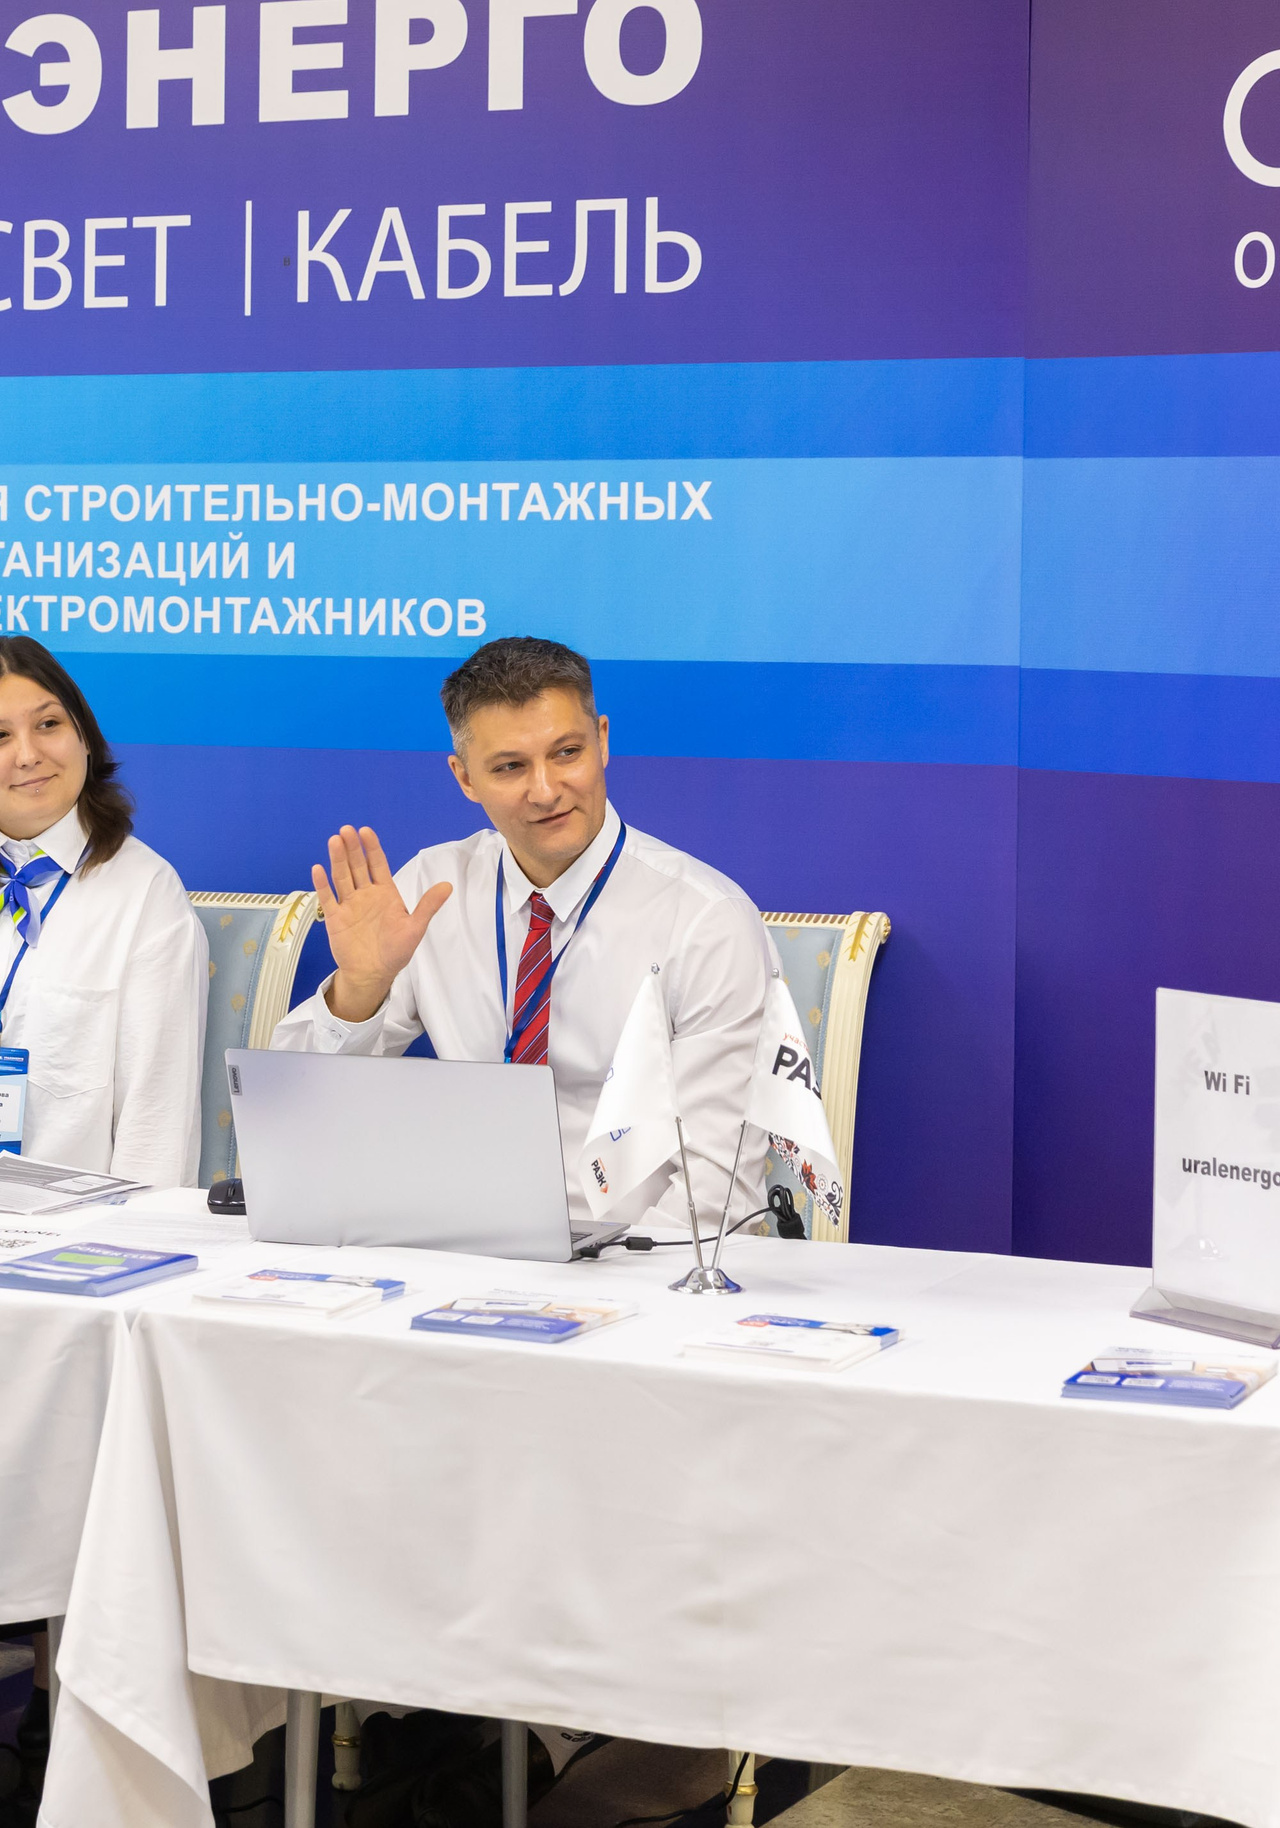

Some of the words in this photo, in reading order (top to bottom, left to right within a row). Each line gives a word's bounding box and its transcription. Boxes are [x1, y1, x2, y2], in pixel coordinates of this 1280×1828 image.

[296, 197, 702, 303] КАБЕЛЬ
[25, 481, 713, 525] СТРОИТЕЛЬНО-МОНТАЖНЫХ
[268, 542, 295, 578] И
[782, 1032, 809, 1052] участ
[231, 1067, 240, 1094] Lenovo
[772, 1044, 822, 1101] РА
[1204, 1070, 1227, 1093] Wi
[1234, 1074, 1250, 1096] Fi
[1182, 1157, 1280, 1190] uralenergo
